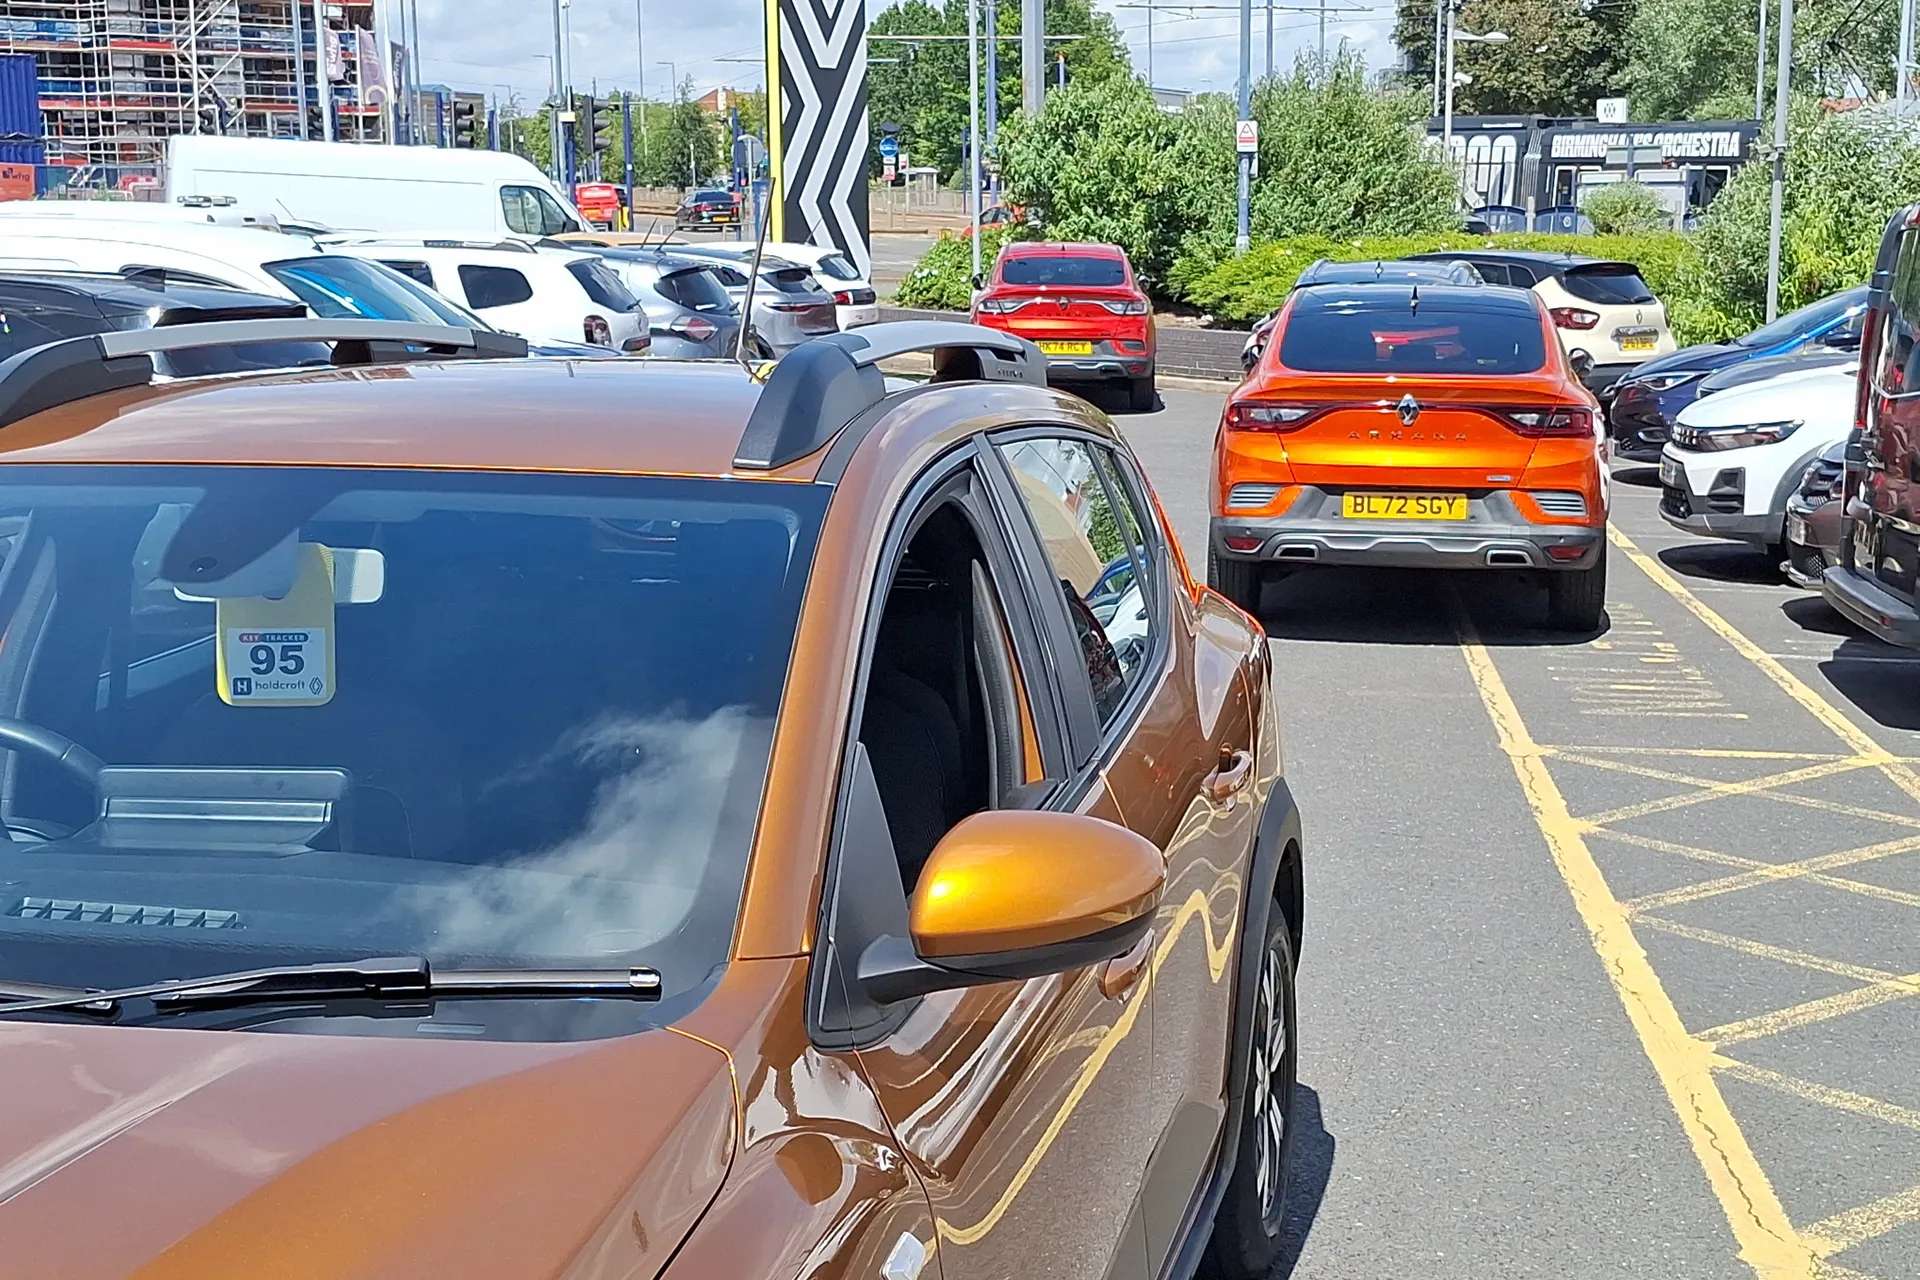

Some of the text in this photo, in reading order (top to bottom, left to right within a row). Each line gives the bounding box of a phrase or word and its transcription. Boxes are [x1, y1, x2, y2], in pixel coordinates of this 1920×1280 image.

[1551, 132, 1740, 157] BIRMINGHA'S ORCHESTRA
[1352, 495, 1457, 515] BL72 SGY
[242, 633, 306, 642] KEY TRACKER
[249, 644, 305, 675] 95
[255, 680, 305, 690] holdcroft
